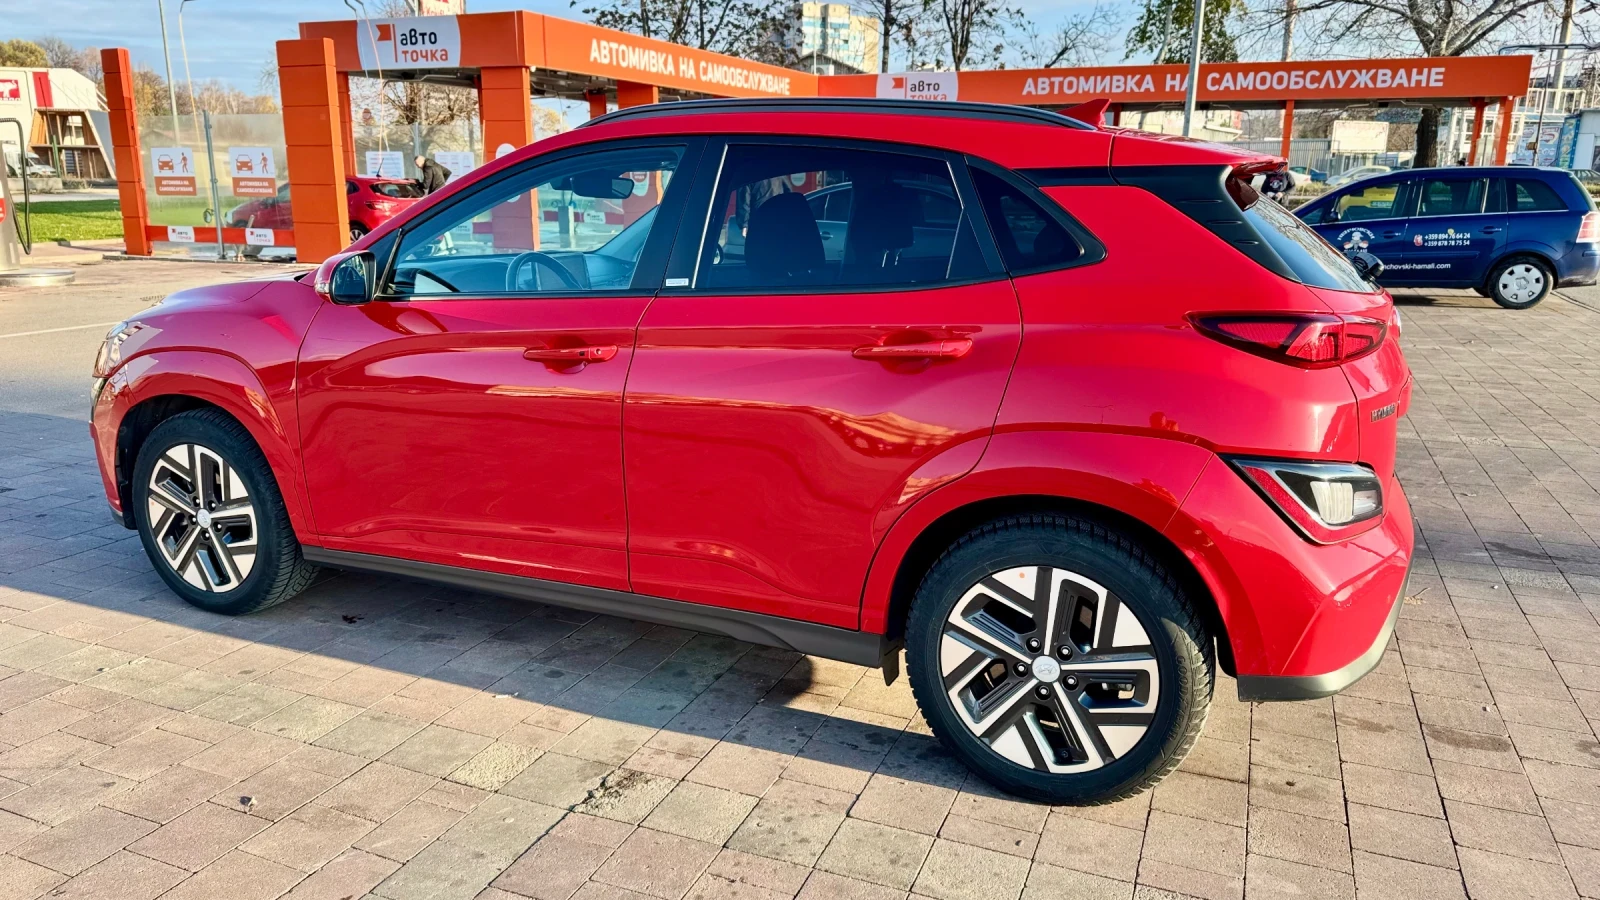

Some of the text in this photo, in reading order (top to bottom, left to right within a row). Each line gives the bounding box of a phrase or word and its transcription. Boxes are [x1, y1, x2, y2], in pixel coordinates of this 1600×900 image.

[400, 28, 438, 46] авто
[401, 48, 449, 63] точка
[590, 38, 791, 96] АВТОМИВКА НА САМООБСЛУЖВАНЕ
[909, 80, 941, 93] авто
[1022, 74, 1155, 96] АВТОМИВКА
[1206, 67, 1446, 91] САМООБСЛУЖВАНЕ
